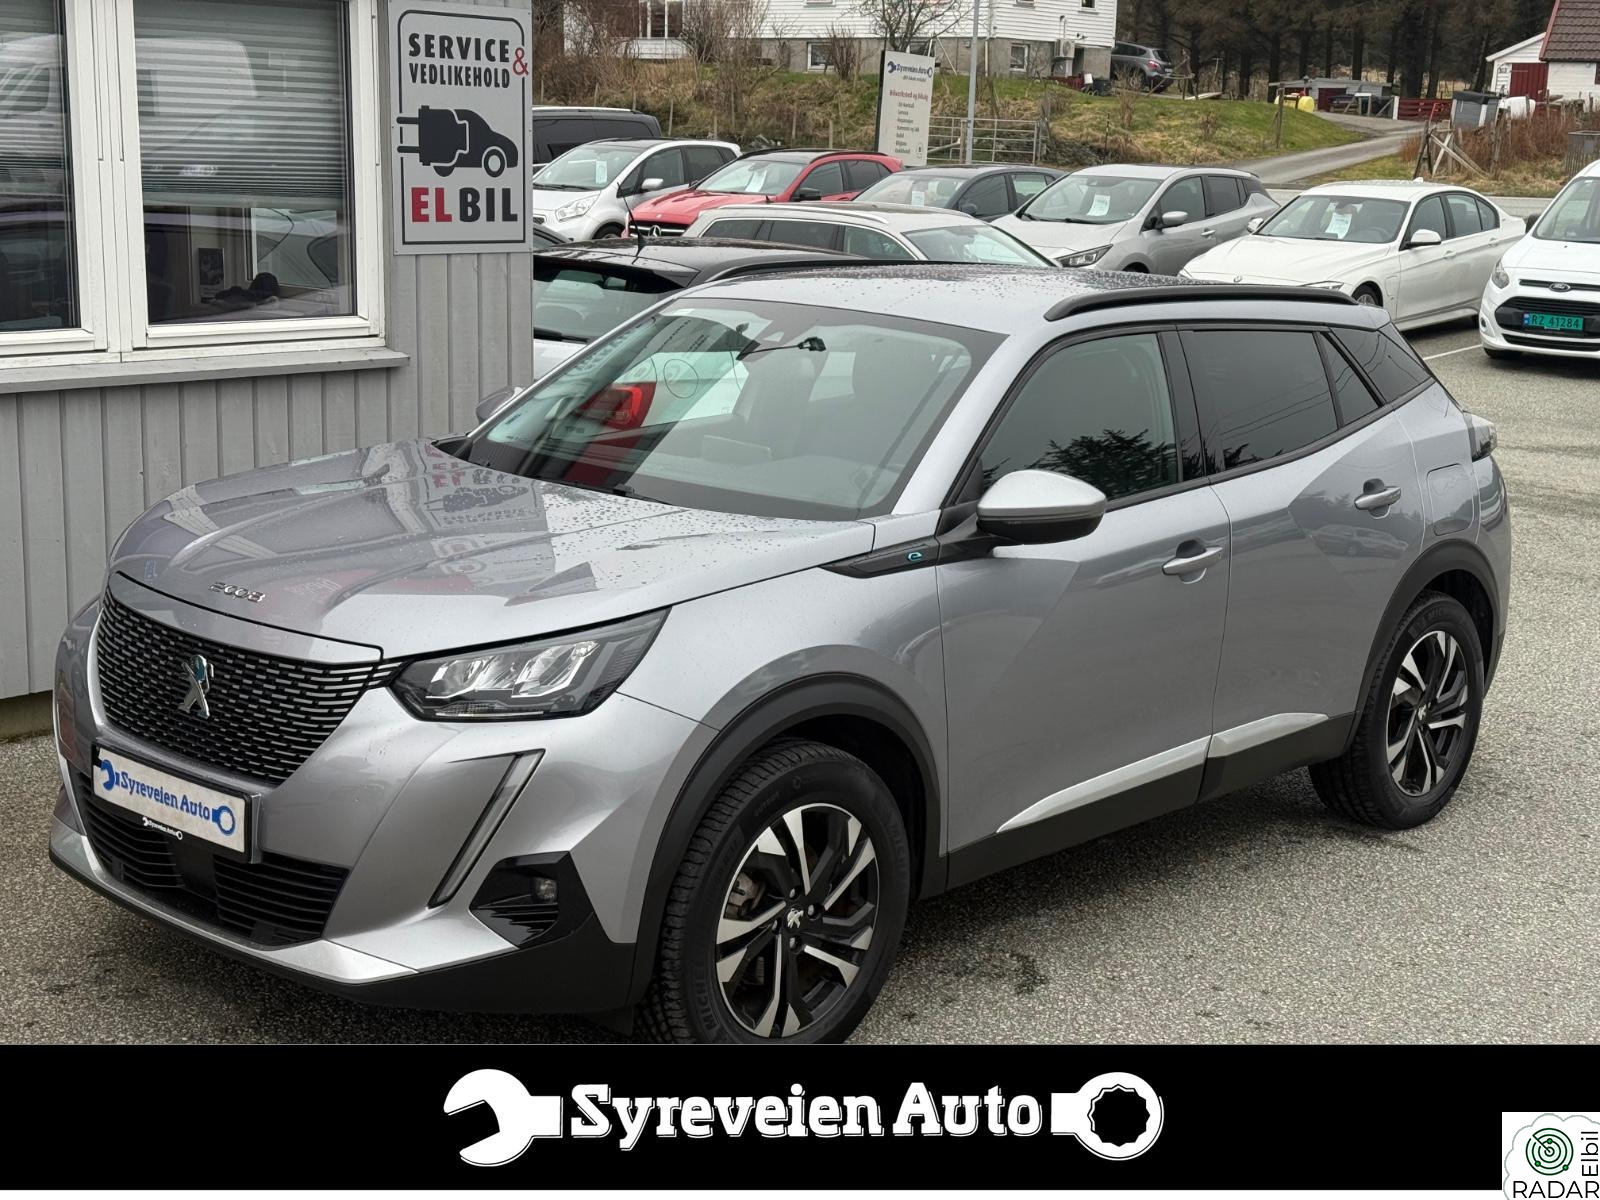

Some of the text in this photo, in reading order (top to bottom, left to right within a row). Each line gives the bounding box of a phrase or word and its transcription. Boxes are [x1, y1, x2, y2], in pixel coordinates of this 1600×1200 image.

[408, 32, 530, 76] SERVICE &
[408, 62, 511, 89] VEDLIKEHOLD
[411, 187, 518, 223] ELBIL
[1531, 314, 1580, 329] RZ 41284
[208, 581, 266, 603] 2008
[121, 771, 211, 820] Syreveien Auto
